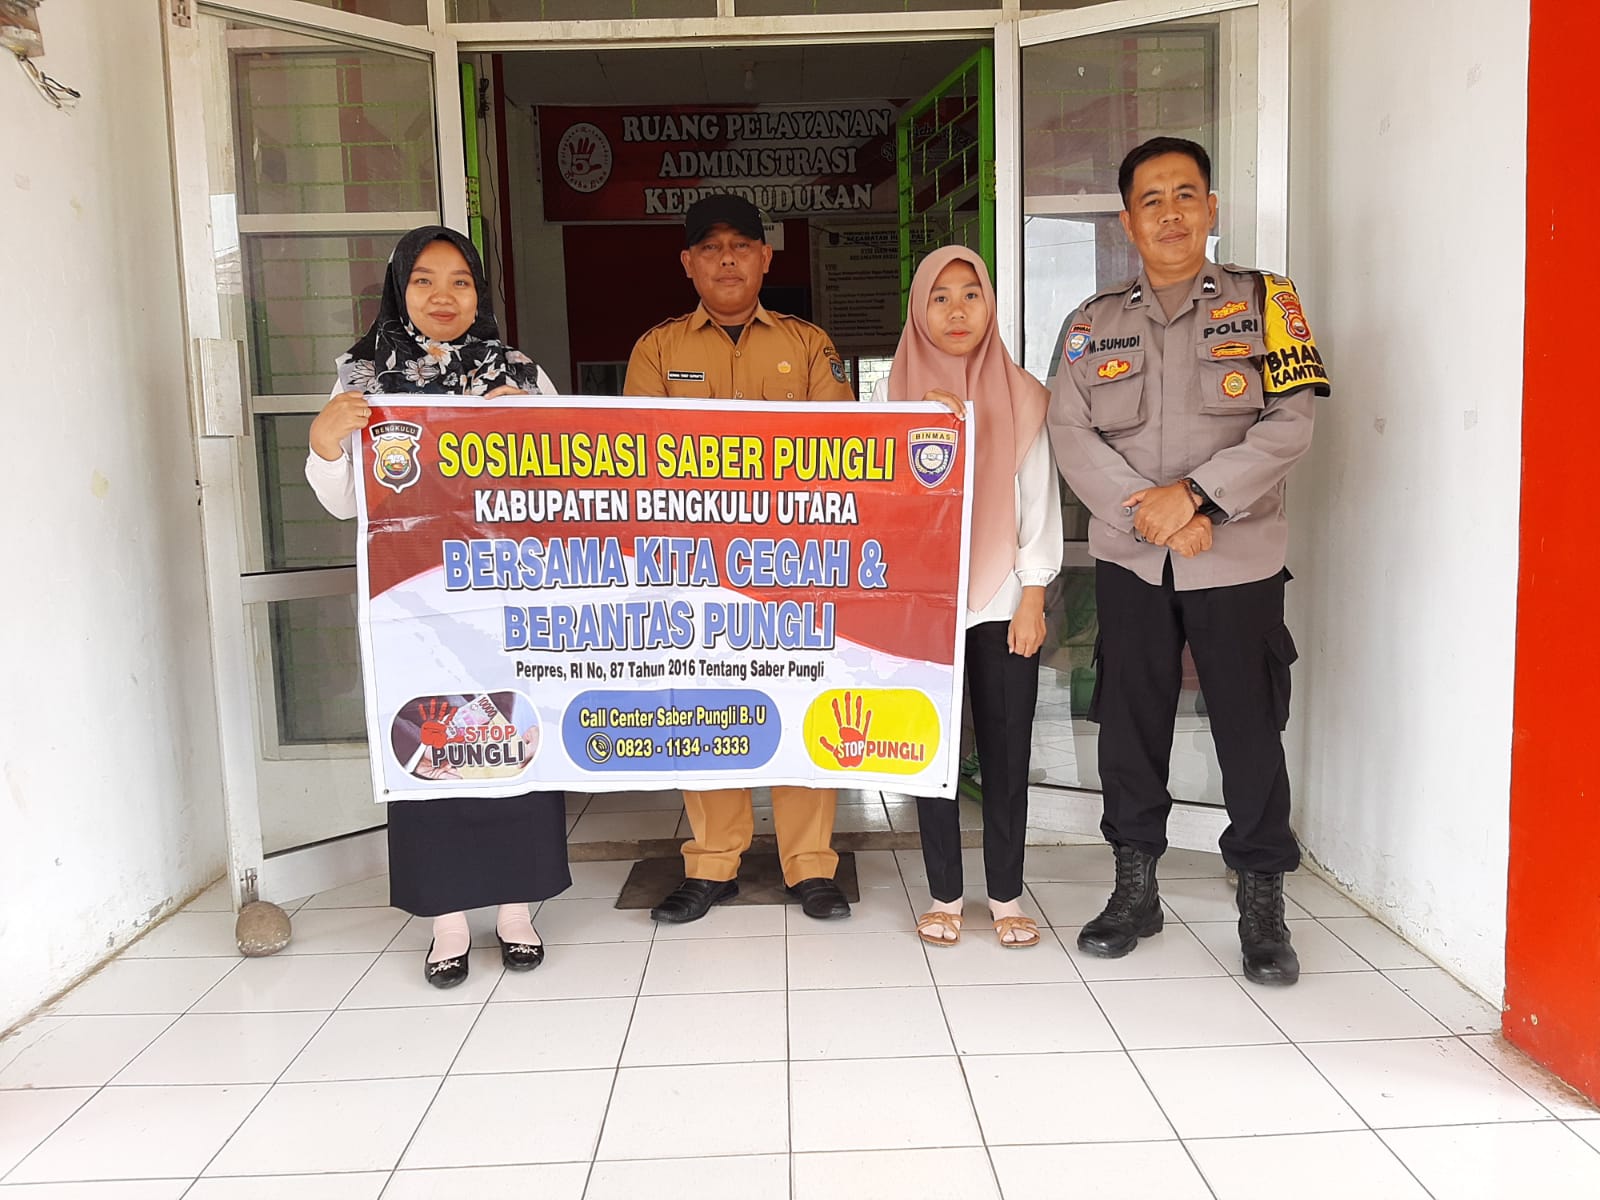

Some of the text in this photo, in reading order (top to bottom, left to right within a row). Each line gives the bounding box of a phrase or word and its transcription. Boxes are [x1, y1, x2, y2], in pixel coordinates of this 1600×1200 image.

[622, 115, 720, 142] RUANG
[725, 109, 891, 140] PELAYANAN
[659, 147, 857, 178] ADMINISTRASI
[1203, 318, 1258, 340] POLRI
[1089, 335, 1140, 354] M.SUHUDI
[374, 425, 417, 436] BENGKULU
[915, 432, 953, 441] BINMAS
[438, 432, 896, 481] SOSIALISASI SABER PUNGLI
[474, 489, 859, 524] KABUPATEN BENGKULU UTARA
[443, 536, 888, 591] BERSAMA KITA CEGAH &
[503, 600, 835, 652] BERANTAS PUNGLI
[516, 659, 824, 682] Perpres, RI No, 87 Tahun 2016 Tentang Saber Pungli
[580, 705, 766, 729] Call Center Saber Pungli B. U
[465, 725, 517, 743] STOP
[431, 741, 524, 768] PUNGLI
[615, 738, 653, 757] 0823
[666, 738, 700, 757] 1134
[713, 736, 749, 756] 3333
[838, 741, 924, 761] STOP PUNGLI
